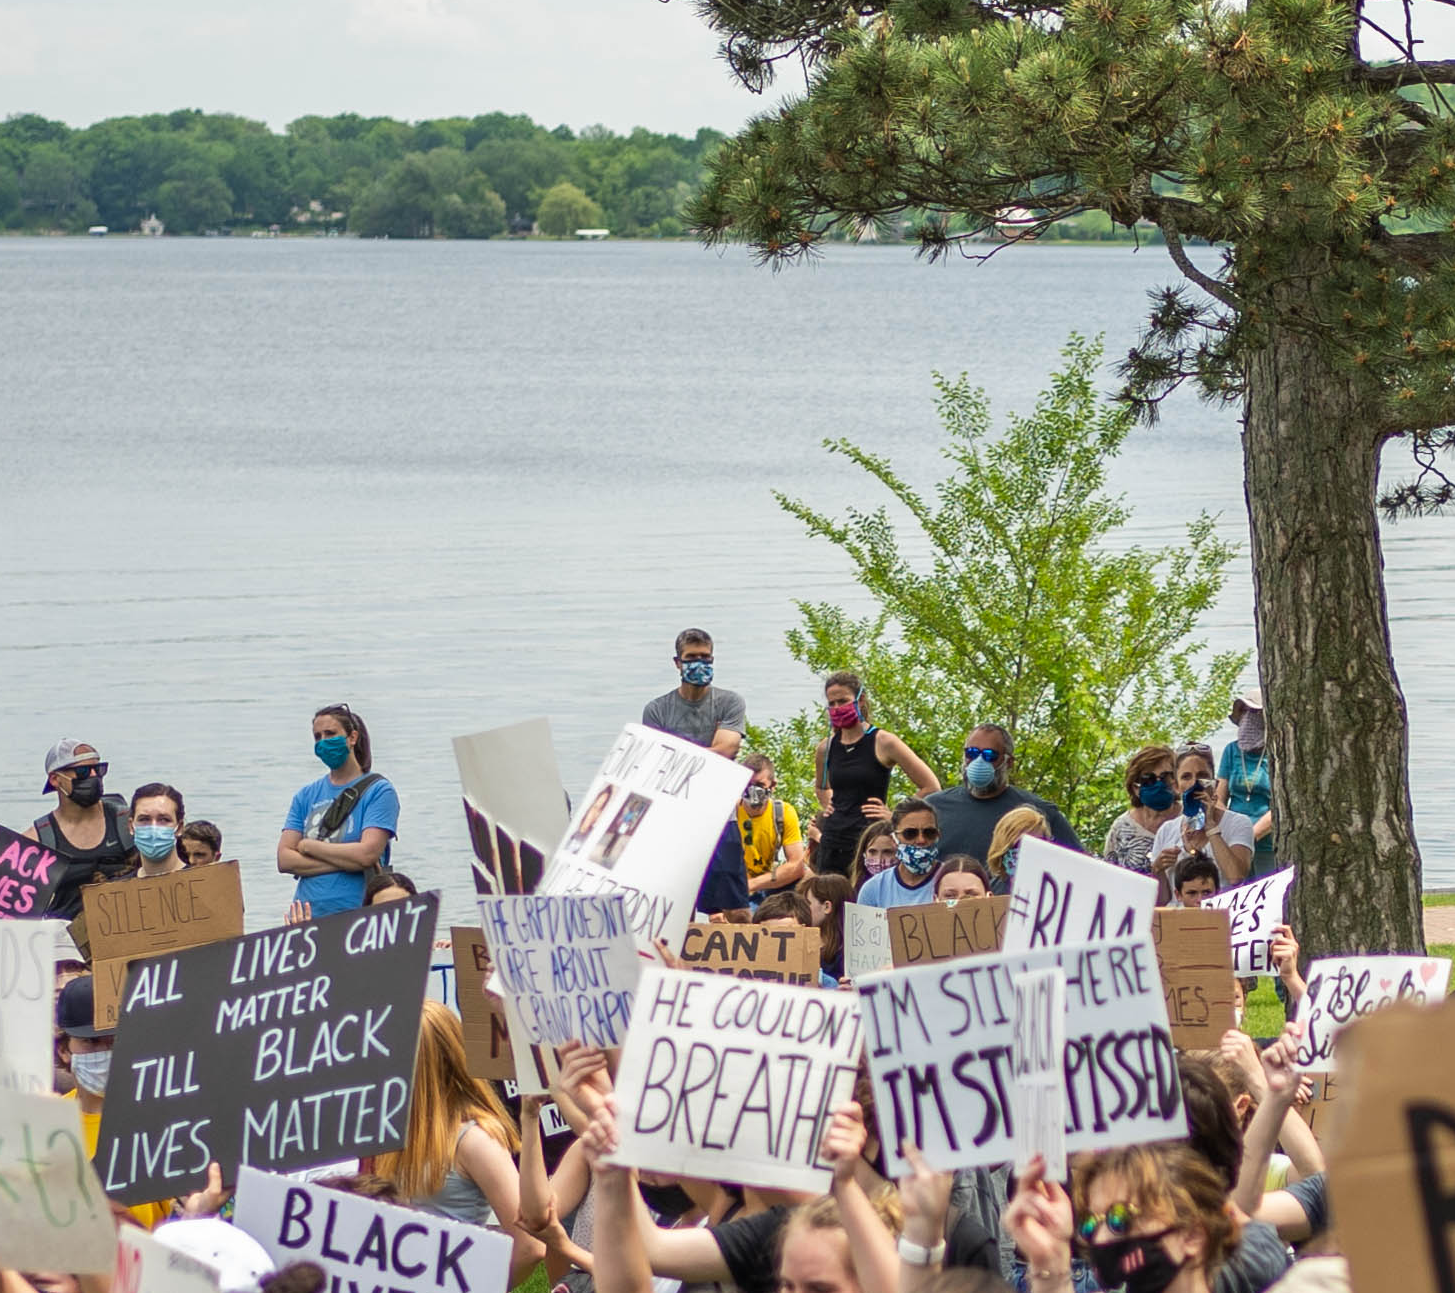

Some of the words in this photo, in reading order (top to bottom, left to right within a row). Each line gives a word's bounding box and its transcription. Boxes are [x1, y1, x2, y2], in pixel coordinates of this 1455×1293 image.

[96, 877, 213, 938] SILENCE
[477, 894, 513, 948] THE
[899, 909, 1005, 964] BLACK
[125, 959, 184, 1013] ALL
[229, 925, 320, 985] LIVES
[344, 901, 429, 956] CAN'T
[494, 946, 541, 998] CARE
[549, 945, 612, 995] ABOUT
[679, 927, 797, 963] CAN'T
[215, 973, 333, 1036] MATTER
[649, 978, 705, 1029] HE
[859, 975, 933, 1060] I'M
[131, 1050, 201, 1103] TILL
[253, 1004, 394, 1083] BLACK
[104, 1117, 214, 1192] LIVES
[242, 1075, 409, 1167] MATTER
[634, 1035, 858, 1172] BREATHE
[882, 1061, 961, 1160] I'M
